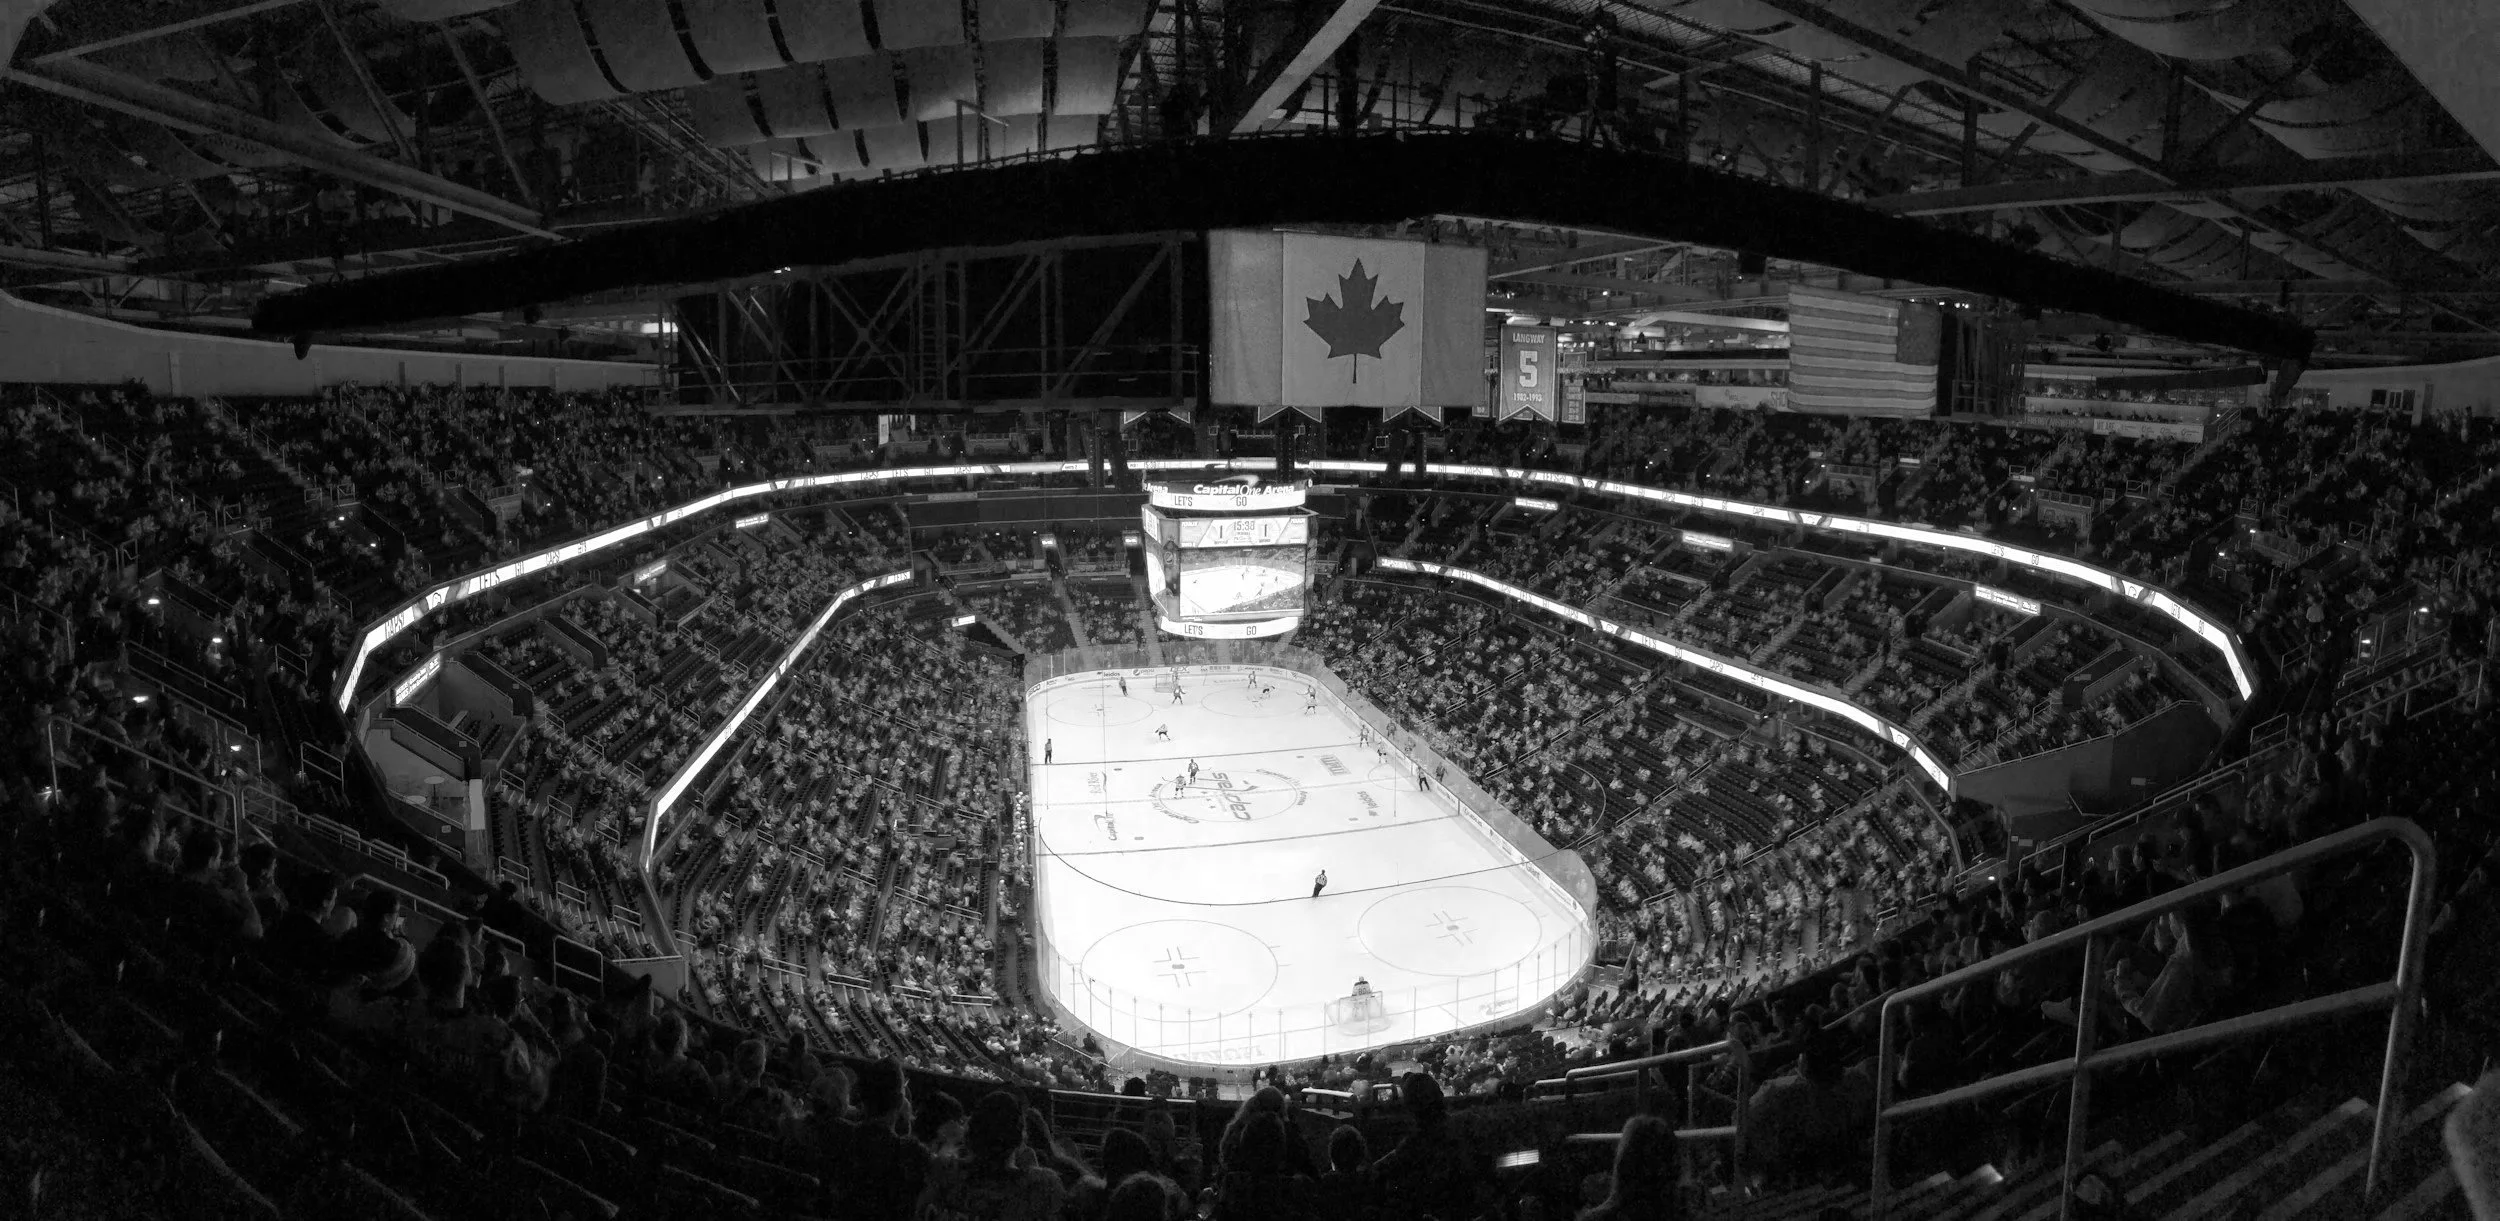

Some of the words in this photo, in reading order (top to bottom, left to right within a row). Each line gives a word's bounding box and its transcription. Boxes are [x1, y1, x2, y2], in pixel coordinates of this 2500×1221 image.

[1513, 332, 1545, 344] LANGWAY
[1519, 350, 1538, 388] 5
[1193, 484, 1240, 495] Capital
[1240, 484, 1262, 496] One
[1263, 484, 1295, 495] Arena
[1174, 496, 1193, 507] LET'S
[1236, 497, 1248, 507] GO
[1184, 624, 1203, 636] LET'S
[1246, 625, 1257, 636] GO
